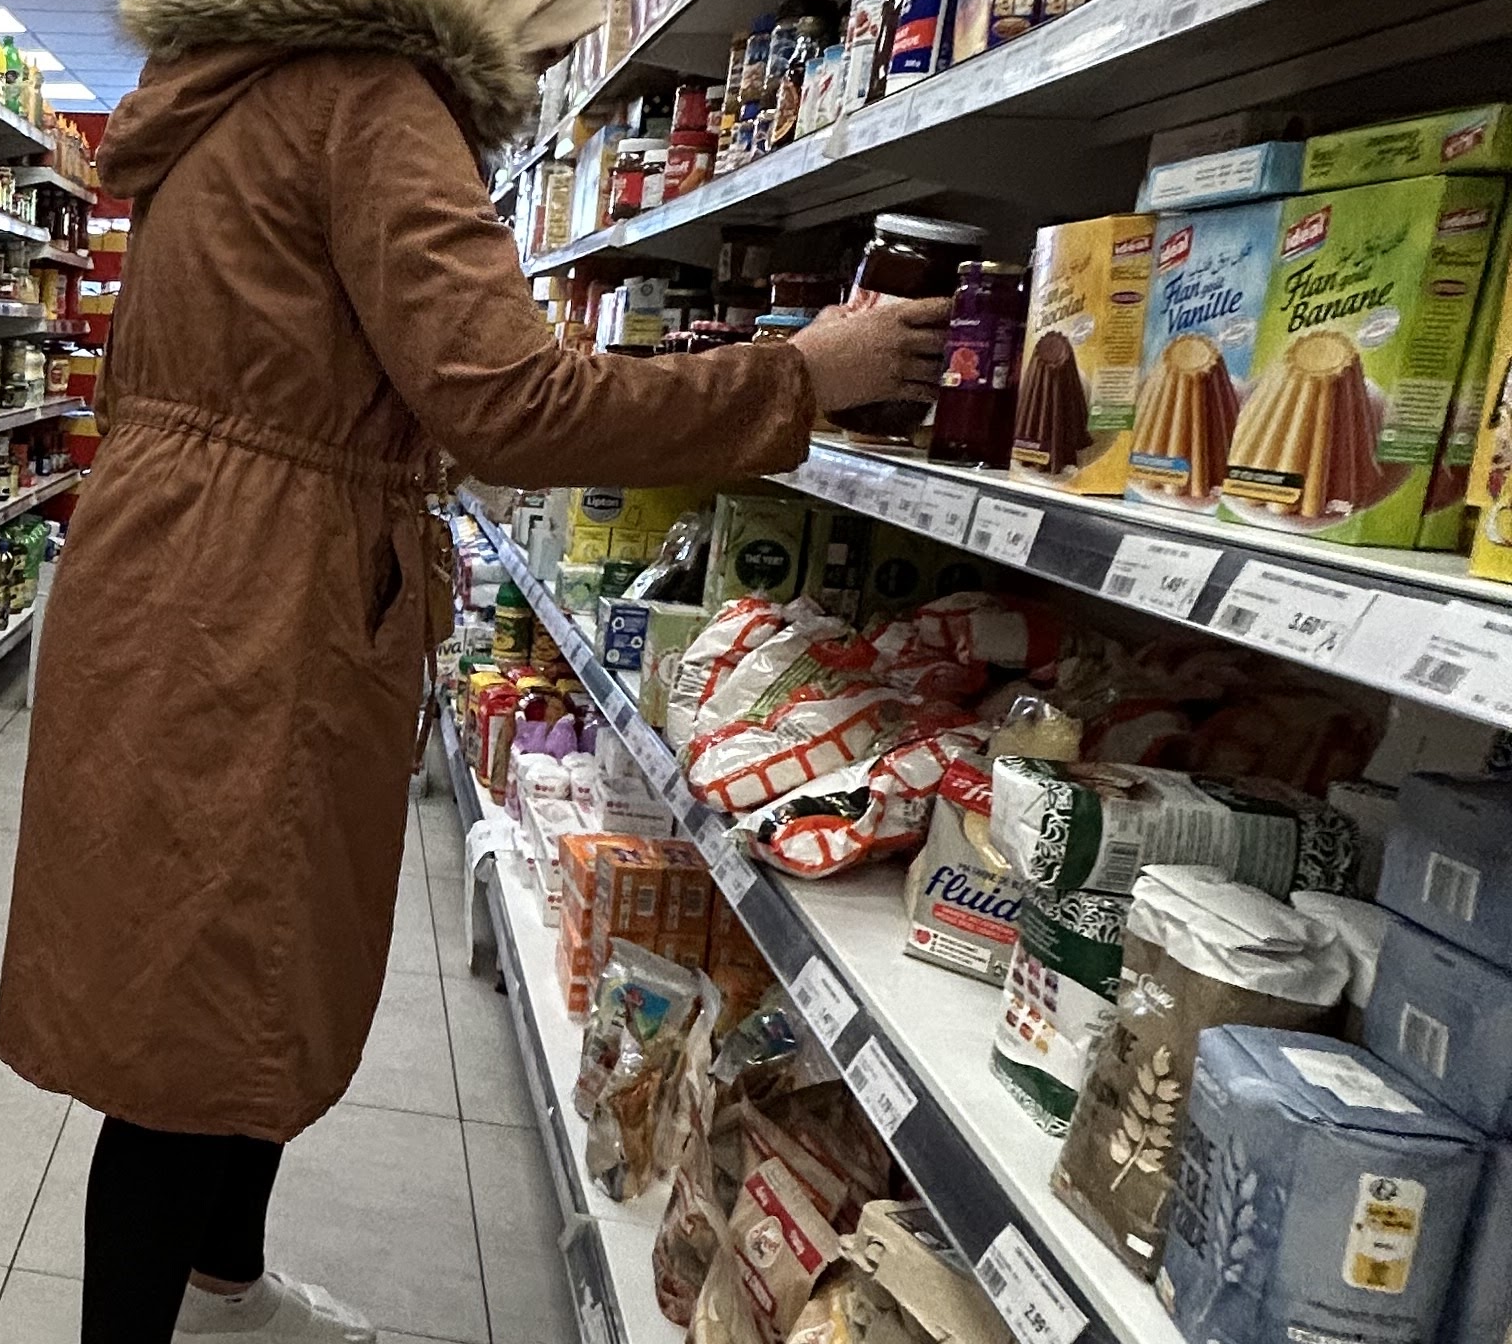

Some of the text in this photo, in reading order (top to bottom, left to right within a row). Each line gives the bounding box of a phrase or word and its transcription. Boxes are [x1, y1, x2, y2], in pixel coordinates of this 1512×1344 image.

[1282, 261, 1338, 311] Flan
[1288, 281, 1395, 332] Banane
[1167, 289, 1243, 334] Vanille
[587, 496, 620, 507] Lipton
